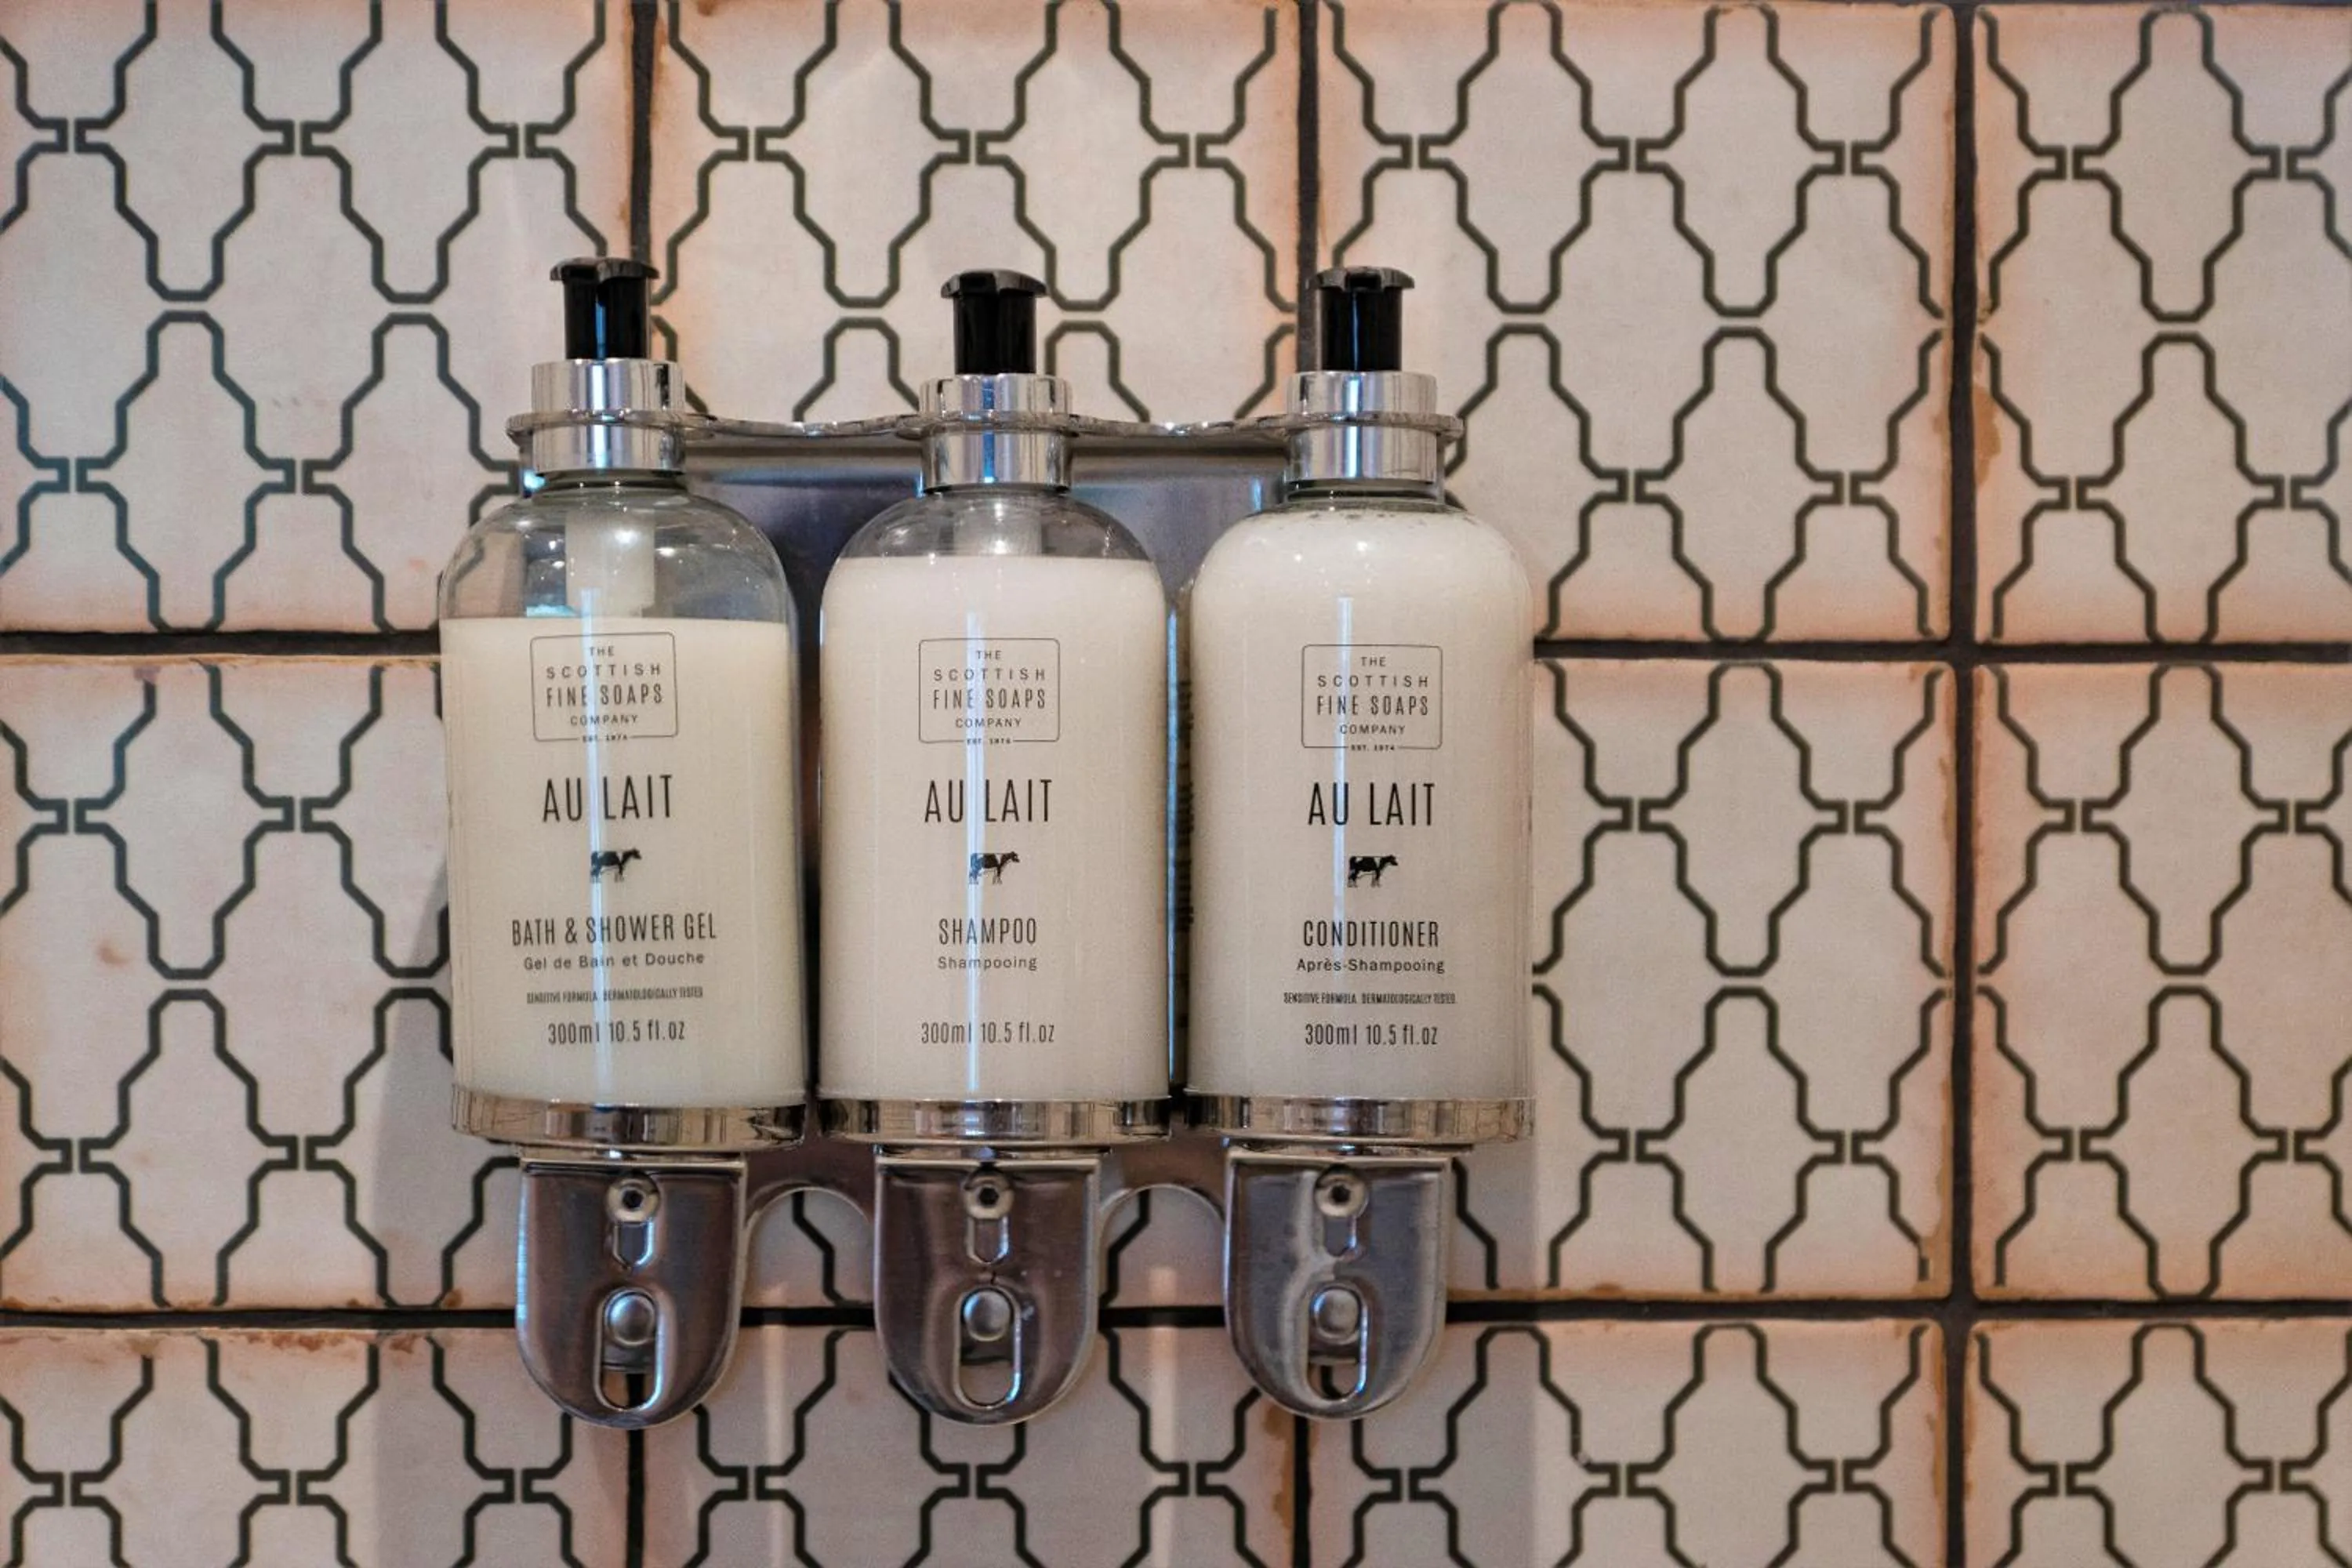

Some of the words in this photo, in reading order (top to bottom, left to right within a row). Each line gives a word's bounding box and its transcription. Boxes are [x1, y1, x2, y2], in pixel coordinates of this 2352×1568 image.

[590, 646, 615, 656] THE
[976, 650, 1002, 660] THE
[1361, 656, 1386, 666] THE
[546, 663, 661, 680] SCOTTISH
[933, 667, 1046, 681] SCOTTISH
[1317, 675, 1428, 688] SCOTTISH
[546, 685, 588, 707] FINE
[600, 683, 663, 705] SOAPS
[933, 688, 975, 710] FINE
[985, 688, 1046, 710] SOAPS
[1317, 695, 1359, 716] FINE
[1370, 695, 1428, 716] SOAPS
[570, 714, 639, 727] COMPANY
[955, 717, 1022, 728] COMPANY
[1339, 724, 1406, 735] COMPANY
[543, 778, 583, 822] AU
[603, 775, 673, 820] LAIT
[924, 779, 964, 823] AU
[985, 779, 1052, 822] LAIT
[1308, 782, 1348, 826] AU
[1370, 782, 1436, 826] LAIT
[512, 918, 556, 946] BATH
[564, 916, 579, 944] &
[586, 913, 675, 944] SHOWER
[684, 912, 717, 940] GEL
[938, 917, 1038, 945] SHAMPOO
[1303, 920, 1439, 948] CONDITIONER
[524, 956, 547, 970] Gel
[554, 955, 572, 969] de
[579, 954, 615, 968] Bain
[622, 954, 638, 967] et
[645, 952, 705, 966] Douche
[938, 956, 1038, 971] Shampooing
[1297, 958, 1446, 975] Après-Shampooing
[548, 1022, 600, 1045] 300ml
[608, 1020, 641, 1043] 10.5
[648, 1019, 685, 1041] fl.oz
[921, 1022, 972, 1044] 300ml
[982, 1022, 1013, 1044] 10.5
[1018, 1022, 1055, 1044] fl.oz
[1305, 1024, 1357, 1046] 300ml
[1366, 1024, 1397, 1046] 10.5
[1403, 1024, 1439, 1046] fl.oz
